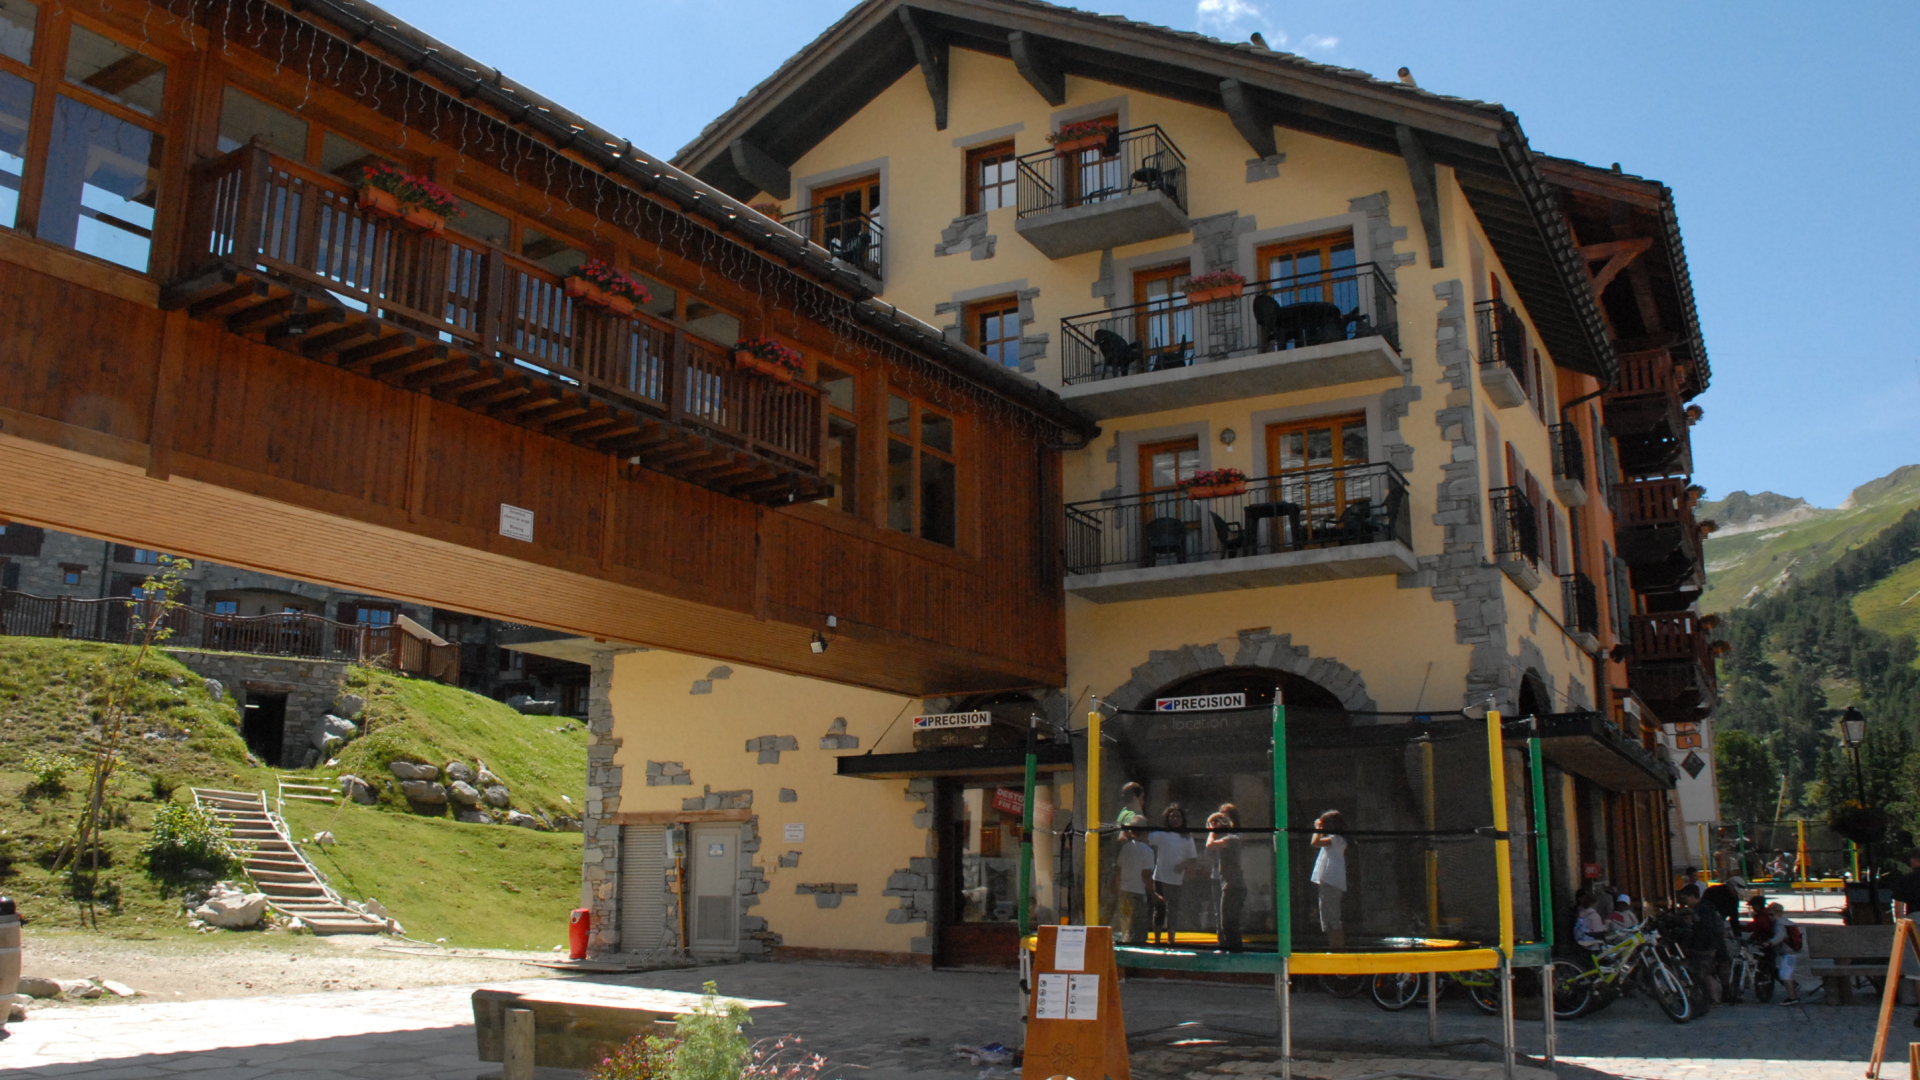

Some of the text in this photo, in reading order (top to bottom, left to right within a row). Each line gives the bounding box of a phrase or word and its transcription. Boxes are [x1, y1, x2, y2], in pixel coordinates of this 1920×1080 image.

[1173, 695, 1242, 710] PRECISION
[928, 713, 987, 727] PRECISION
[1172, 717, 1228, 730] location
[998, 799, 1023, 813] FIN DE
